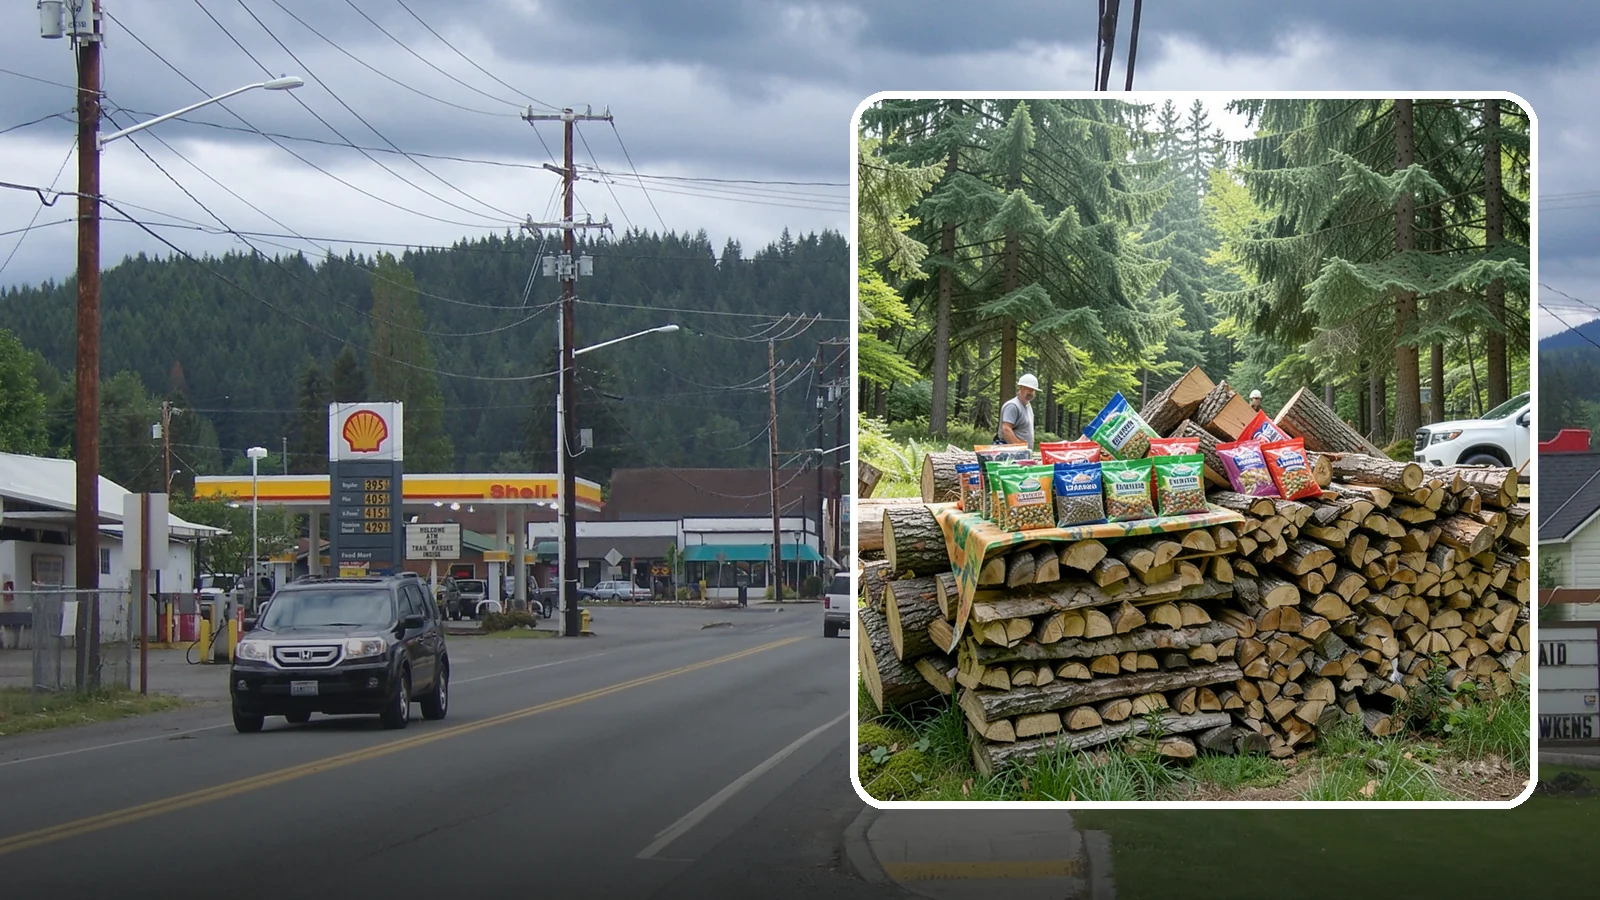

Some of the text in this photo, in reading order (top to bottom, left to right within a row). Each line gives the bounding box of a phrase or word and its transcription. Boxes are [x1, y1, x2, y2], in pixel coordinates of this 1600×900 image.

[366, 480, 383, 490] 395
[490, 484, 547, 499] Shell
[366, 494, 383, 504] 405
[366, 508, 383, 518] 415
[366, 522, 383, 533] 429
